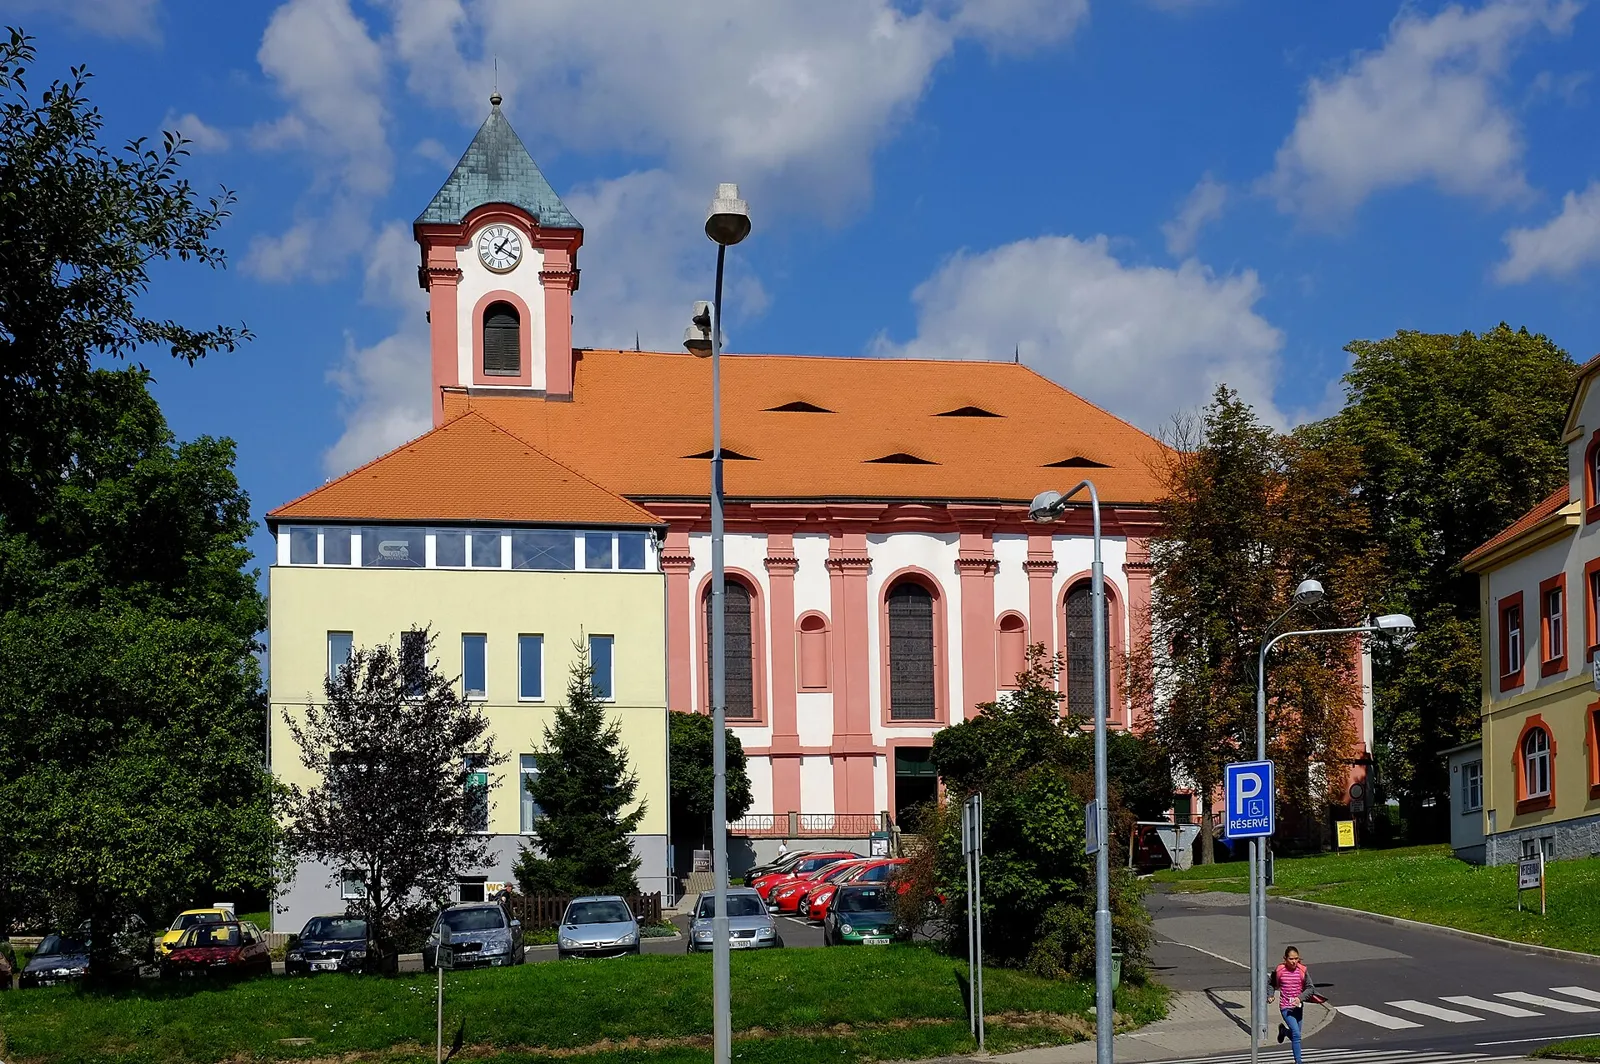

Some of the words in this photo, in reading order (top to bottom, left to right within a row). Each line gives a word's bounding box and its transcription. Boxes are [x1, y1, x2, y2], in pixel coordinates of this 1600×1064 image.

[1236, 772, 1262, 815] P
[1230, 816, 1269, 829] RÉSERVÉ
[486, 883, 503, 892] WC
